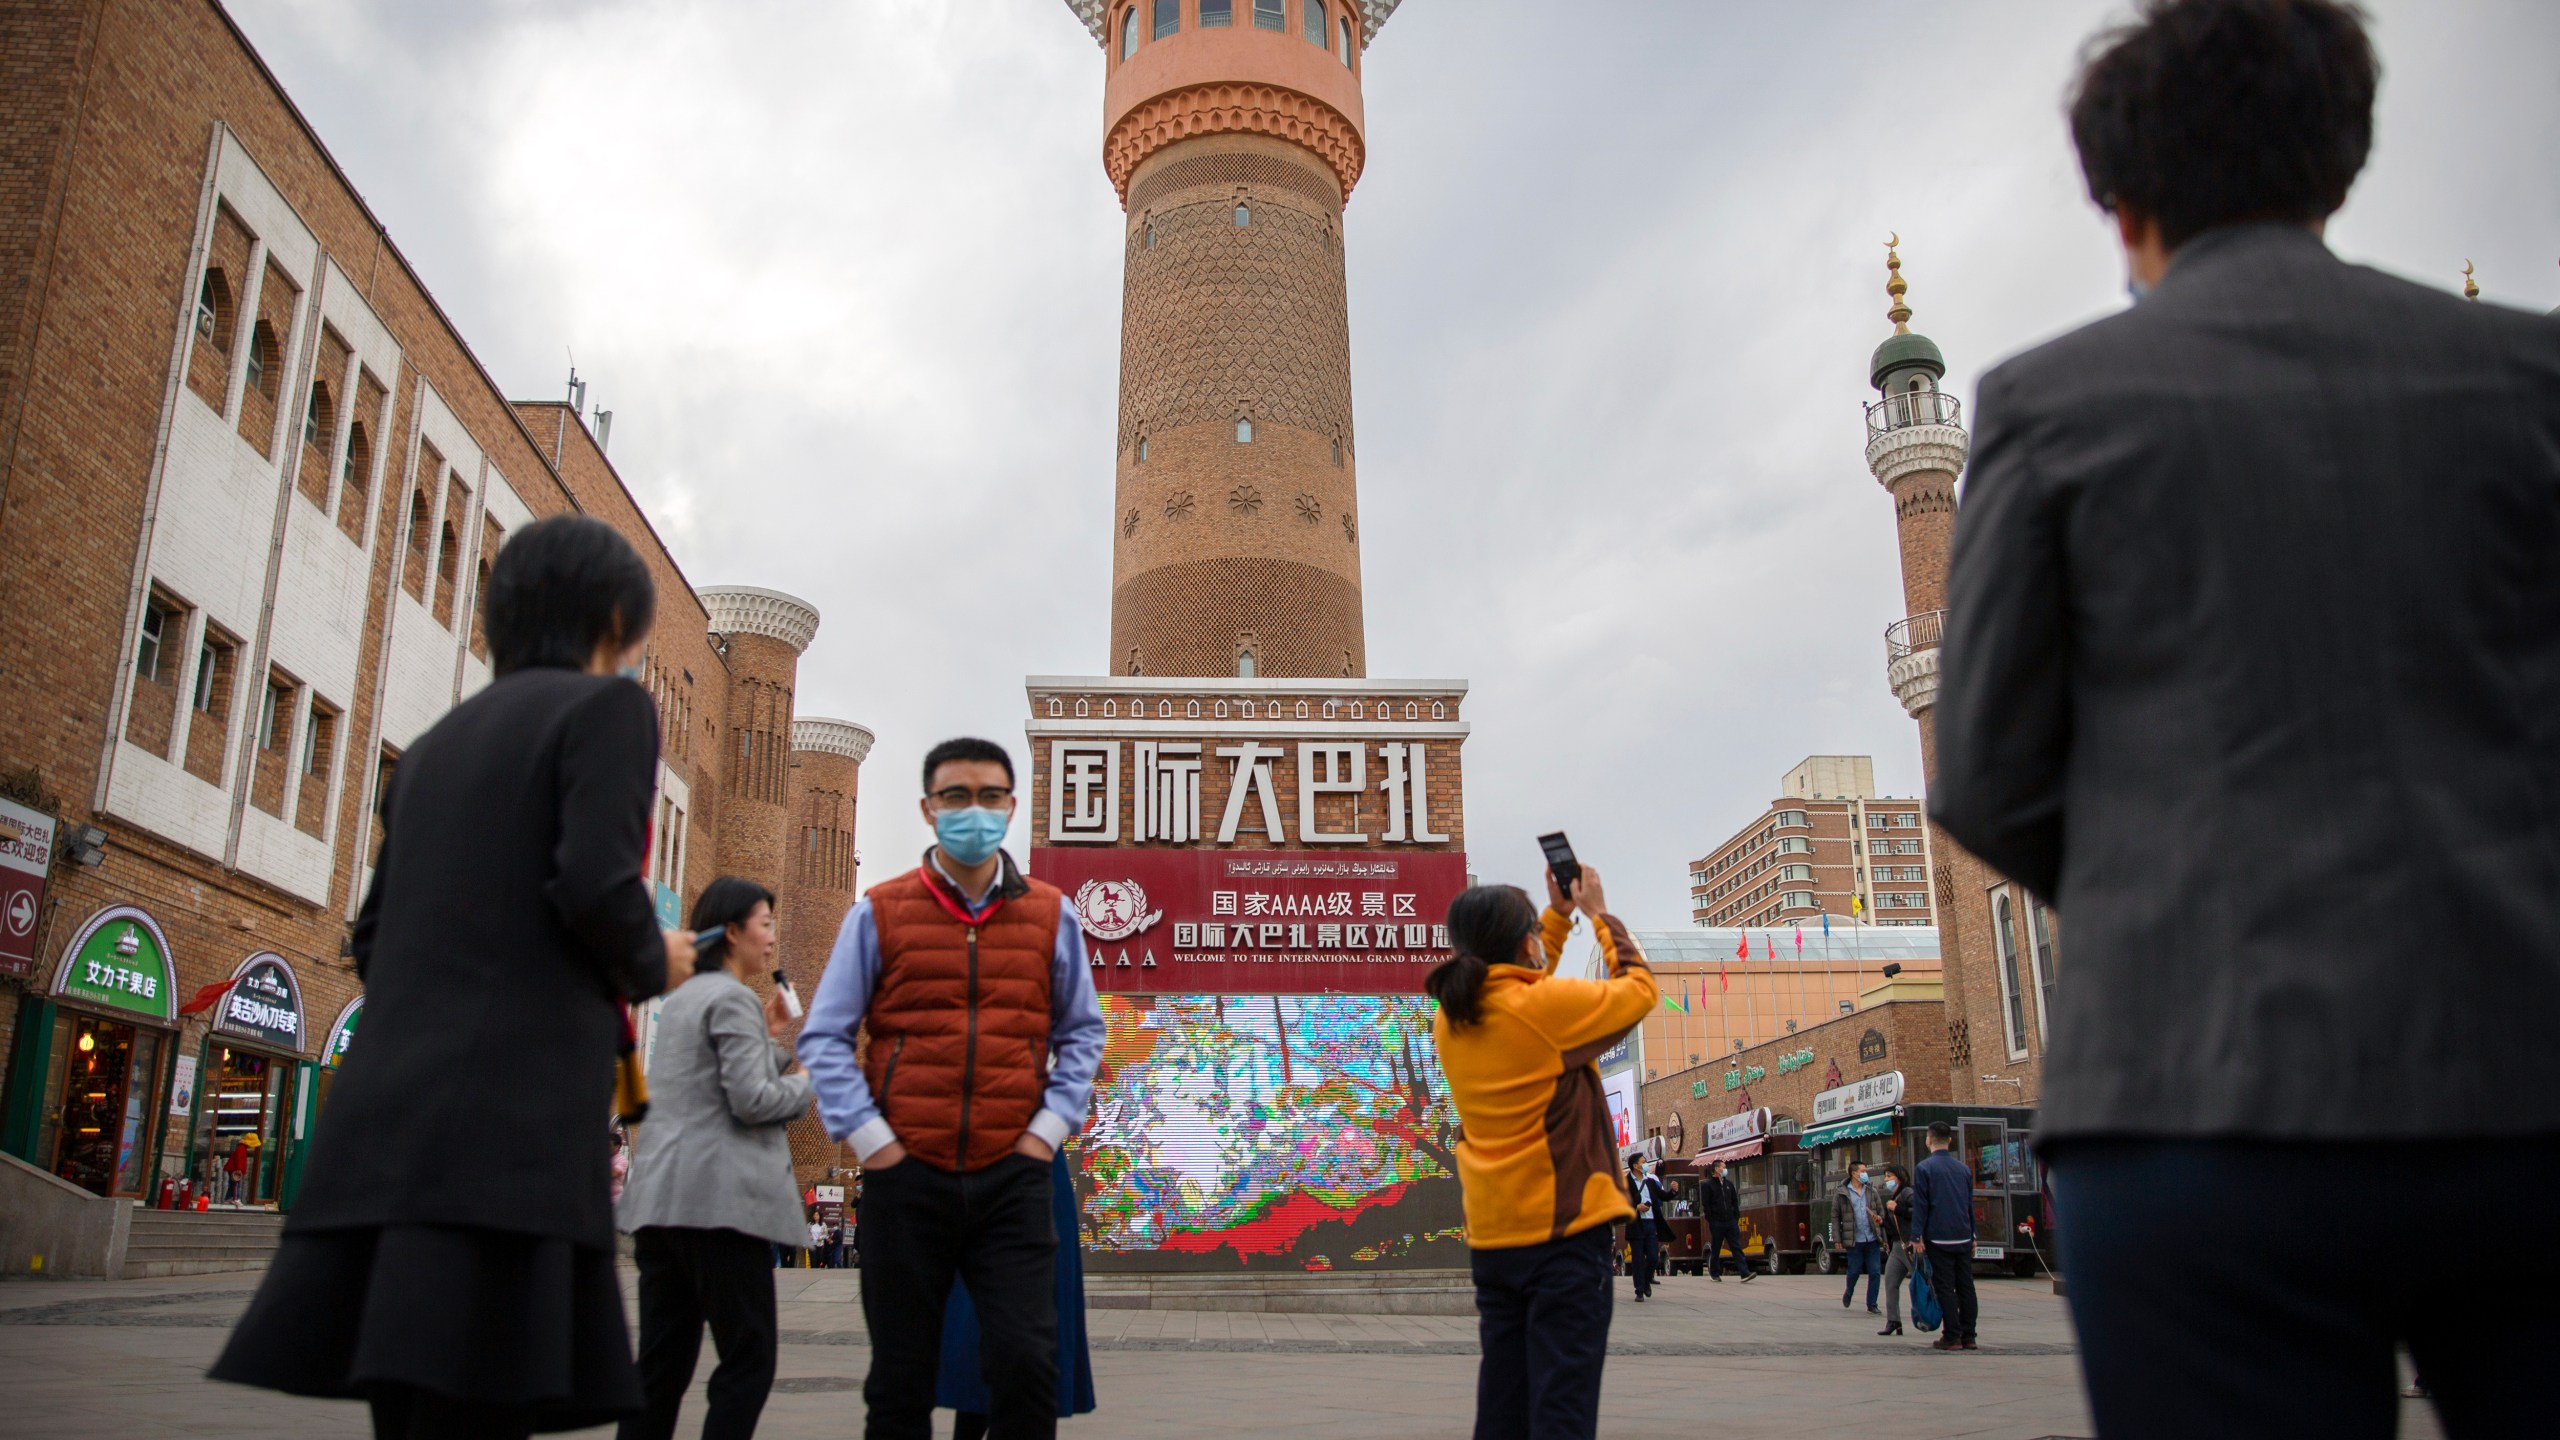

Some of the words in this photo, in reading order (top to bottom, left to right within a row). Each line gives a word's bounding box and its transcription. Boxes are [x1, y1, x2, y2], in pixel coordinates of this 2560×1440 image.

[1049, 740, 1450, 843] 国际大巴扎
[1213, 890, 1417, 917] 国家AAAA级景区
[1173, 922, 1453, 949] 国际大巴扎景区欢迎您
[1174, 953, 1226, 962] WELCOME
[1233, 954, 1248, 963] TO
[1252, 954, 1274, 963] THE
[1279, 954, 1364, 963] INTERNATIONAL
[1367, 954, 1405, 963] GRAND
[86, 959, 157, 998] 艾力干果店
[229, 995, 298, 1034] 英吉沙小刀专卖
